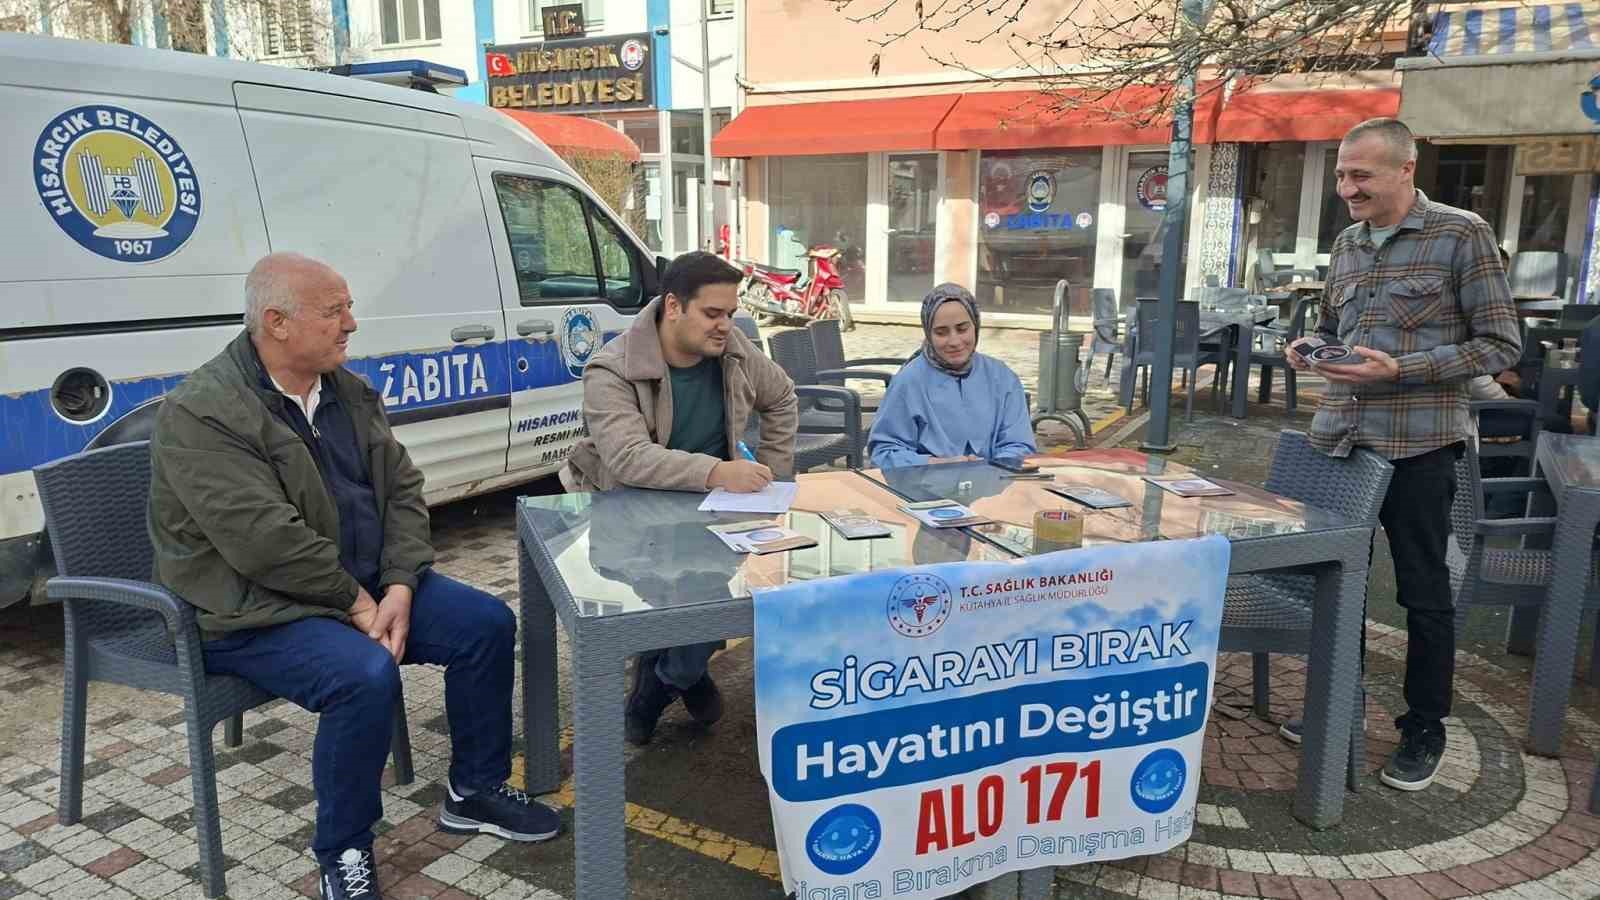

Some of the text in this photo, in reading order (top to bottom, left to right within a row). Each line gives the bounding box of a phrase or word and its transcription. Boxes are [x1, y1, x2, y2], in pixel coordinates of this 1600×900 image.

[491, 73, 645, 108] BELEDİYESİ
[40, 110, 198, 216] HİSARCIK BELEDİYESİ
[114, 240, 152, 255] 1967
[380, 353, 489, 406] ZABITA
[960, 568, 1113, 598] T.C. SAĞLIK BAKANLIĞI
[809, 620, 1194, 708] SİGARAYI BIRAK
[796, 682, 1200, 781] Hayatını Değiştir
[914, 759, 1101, 856] ALO 171
[794, 878, 882, 900] igara
[892, 843, 1008, 895] Bırakma
[1016, 825, 1145, 859] Danışma
